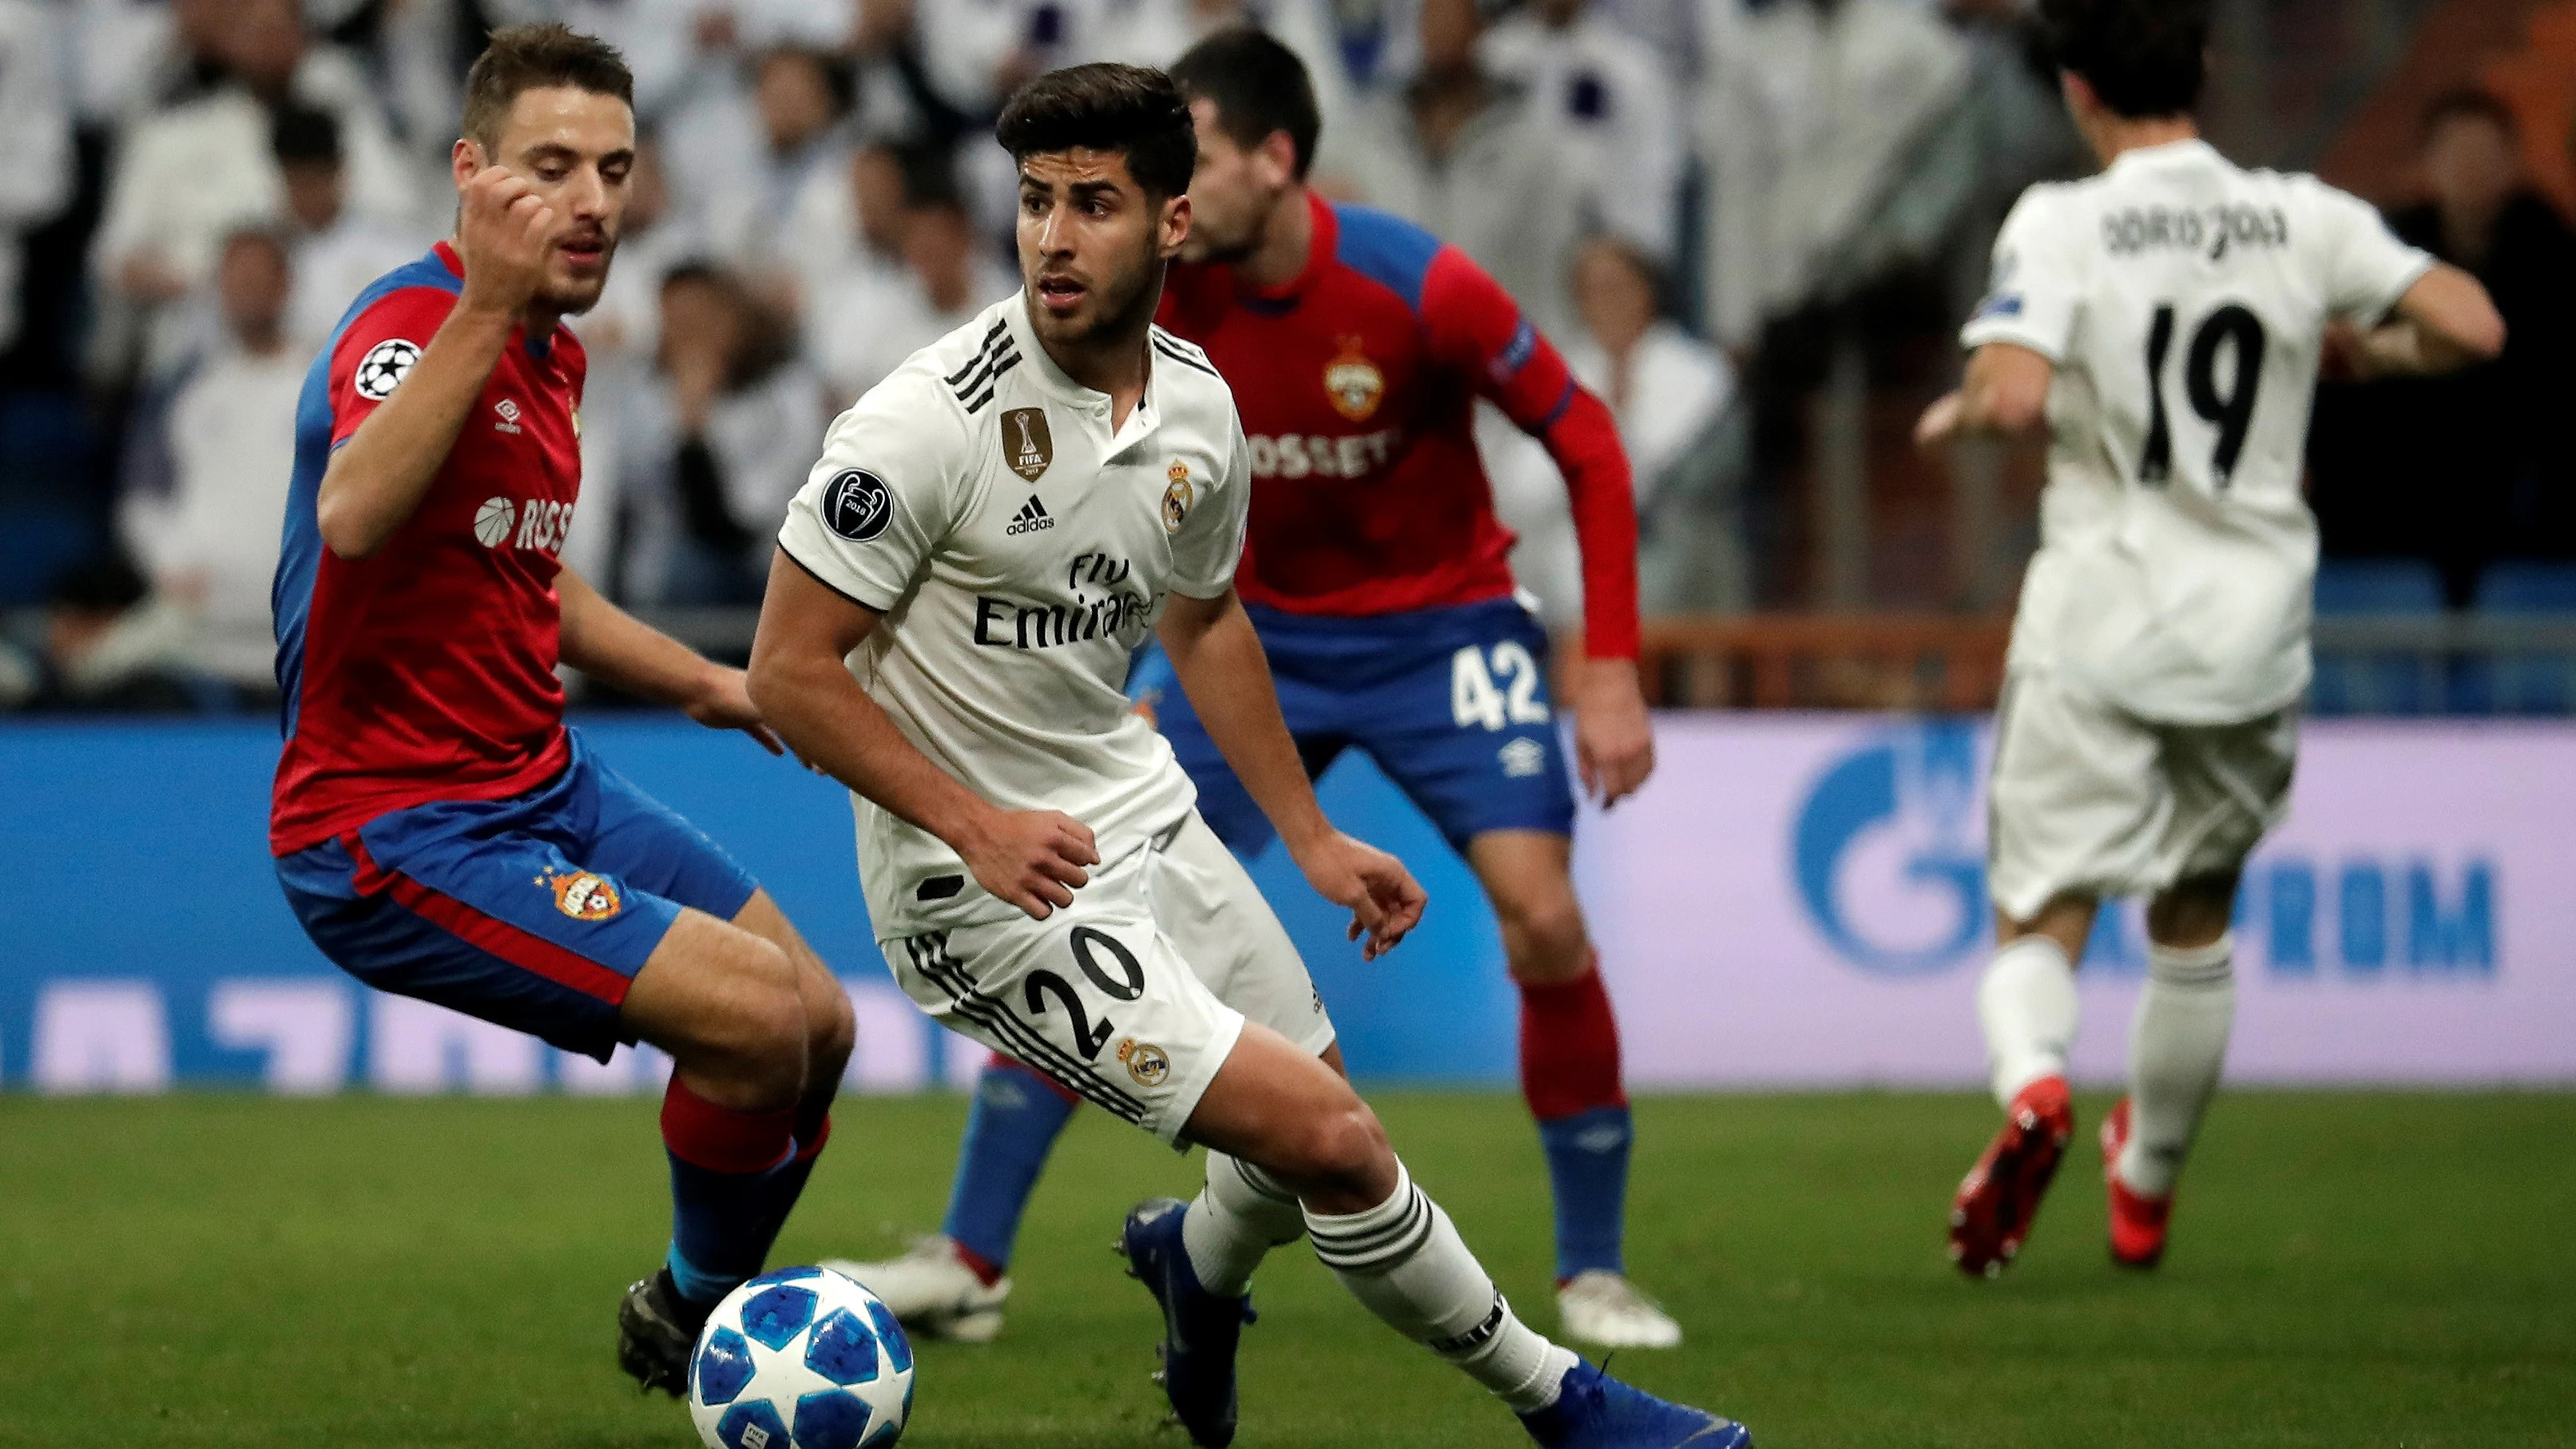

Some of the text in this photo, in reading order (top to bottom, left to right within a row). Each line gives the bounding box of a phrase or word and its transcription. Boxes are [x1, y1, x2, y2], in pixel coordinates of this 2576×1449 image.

[2138, 292, 2265, 487] 19
[1018, 454, 1042, 466] FIFA
[1006, 518, 1054, 535] adidas
[1451, 641, 1548, 731] 42
[1025, 927, 1144, 1062] 20
